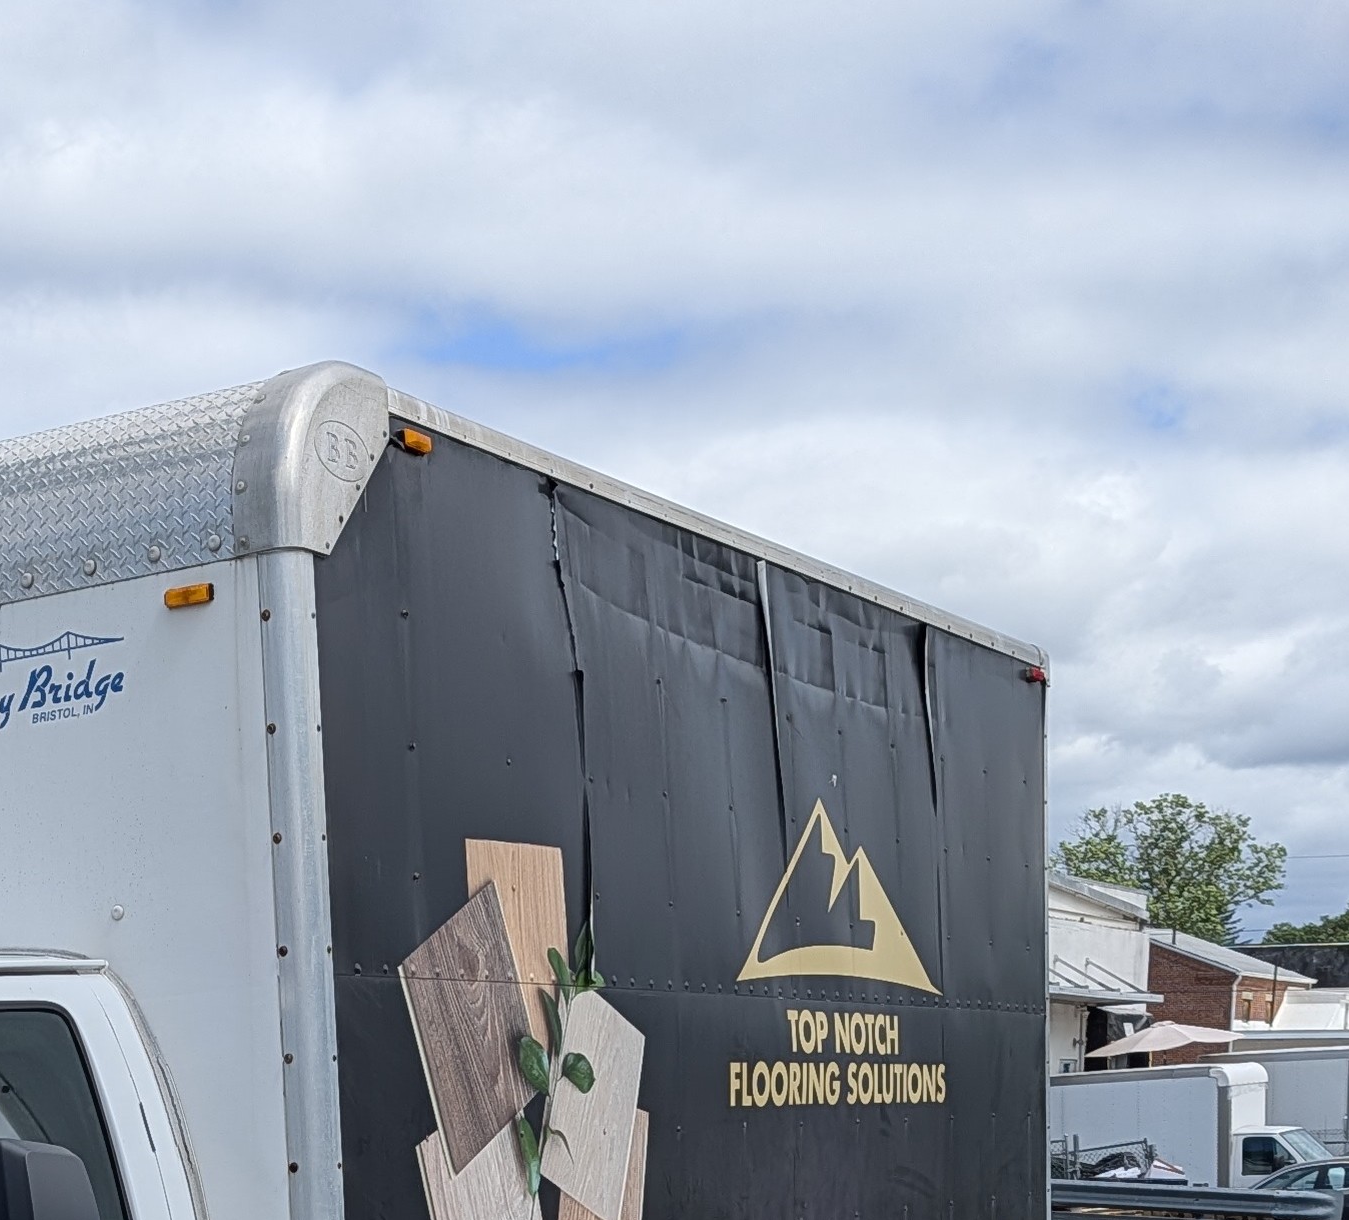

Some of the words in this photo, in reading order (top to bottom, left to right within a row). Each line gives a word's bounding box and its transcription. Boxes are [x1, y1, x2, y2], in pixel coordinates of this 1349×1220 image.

[18, 658, 125, 712] Bridge
[32, 708, 81, 724] BRISTOL,
[82, 703, 94, 715] IN
[786, 1009, 829, 1055] TOP
[833, 1012, 899, 1056] NOTCH
[729, 1060, 841, 1108] FLOORING
[846, 1061, 947, 1105] SOLUTIONS
